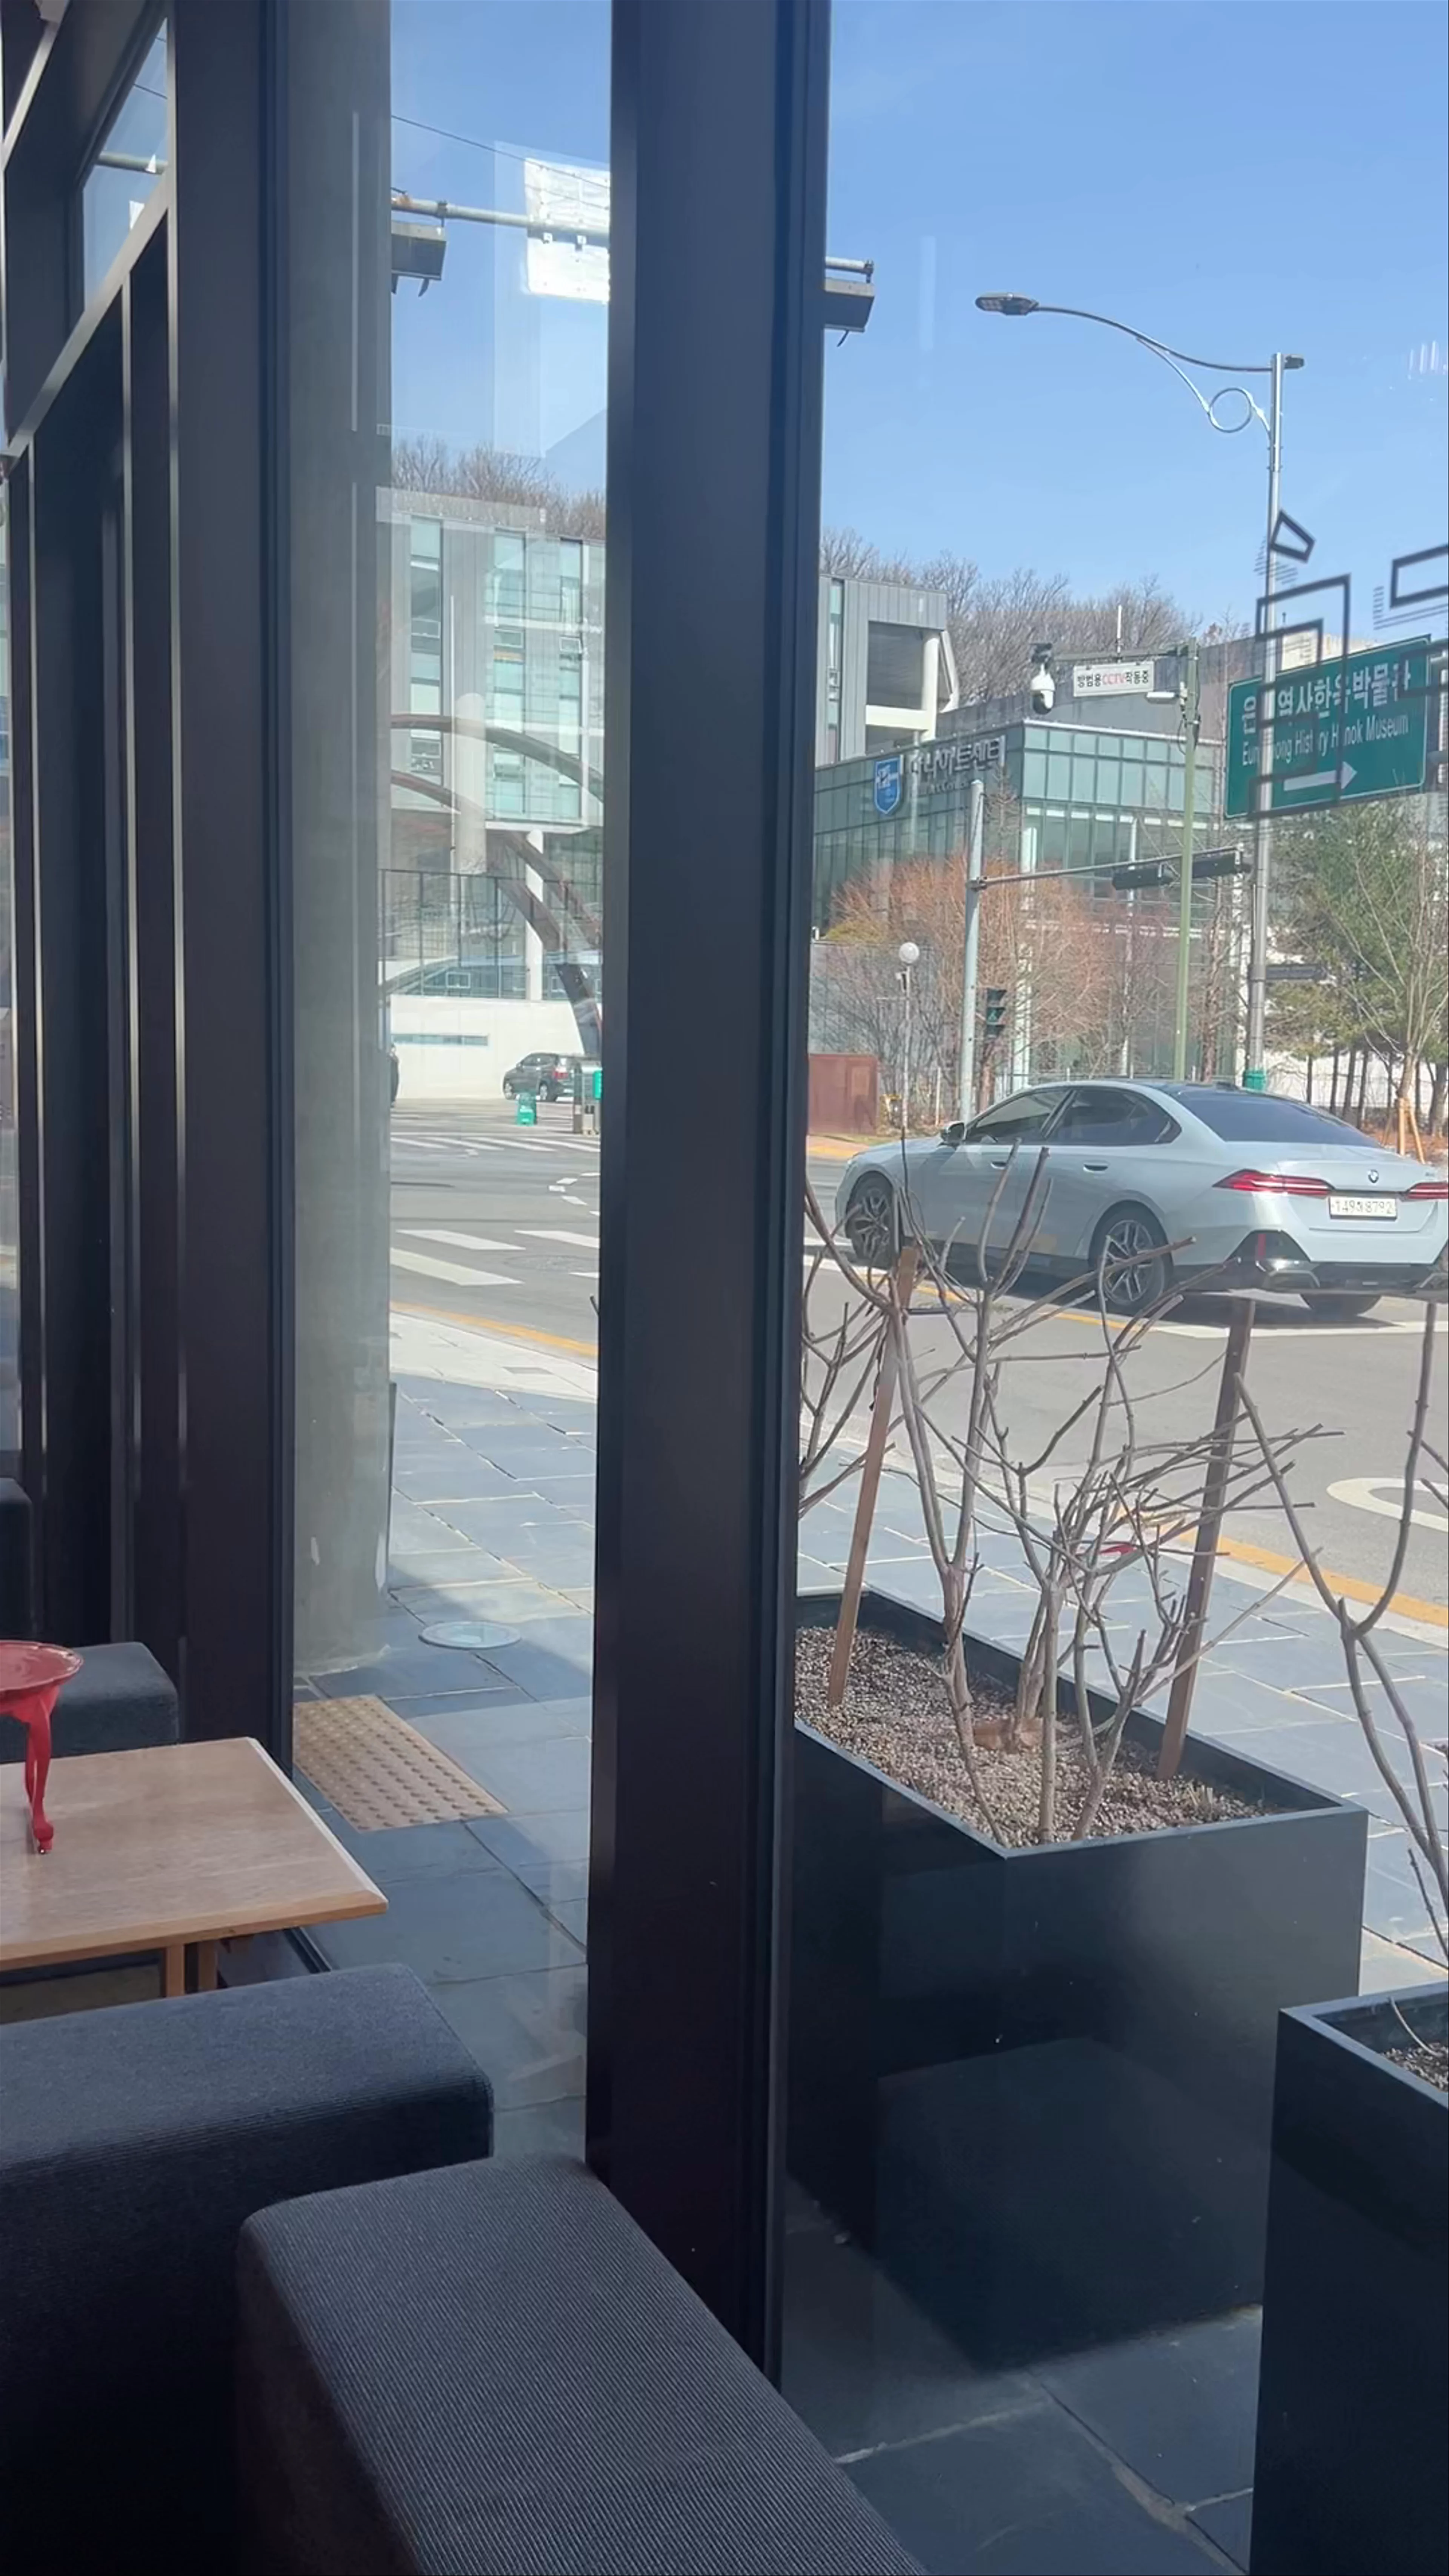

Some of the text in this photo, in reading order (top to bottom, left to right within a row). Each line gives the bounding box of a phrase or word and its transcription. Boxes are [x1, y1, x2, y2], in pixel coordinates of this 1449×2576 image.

[1241, 660, 1411, 734] 은역사한옥박물관
[1243, 713, 1409, 766] Eunong Histry Hnok Museum
